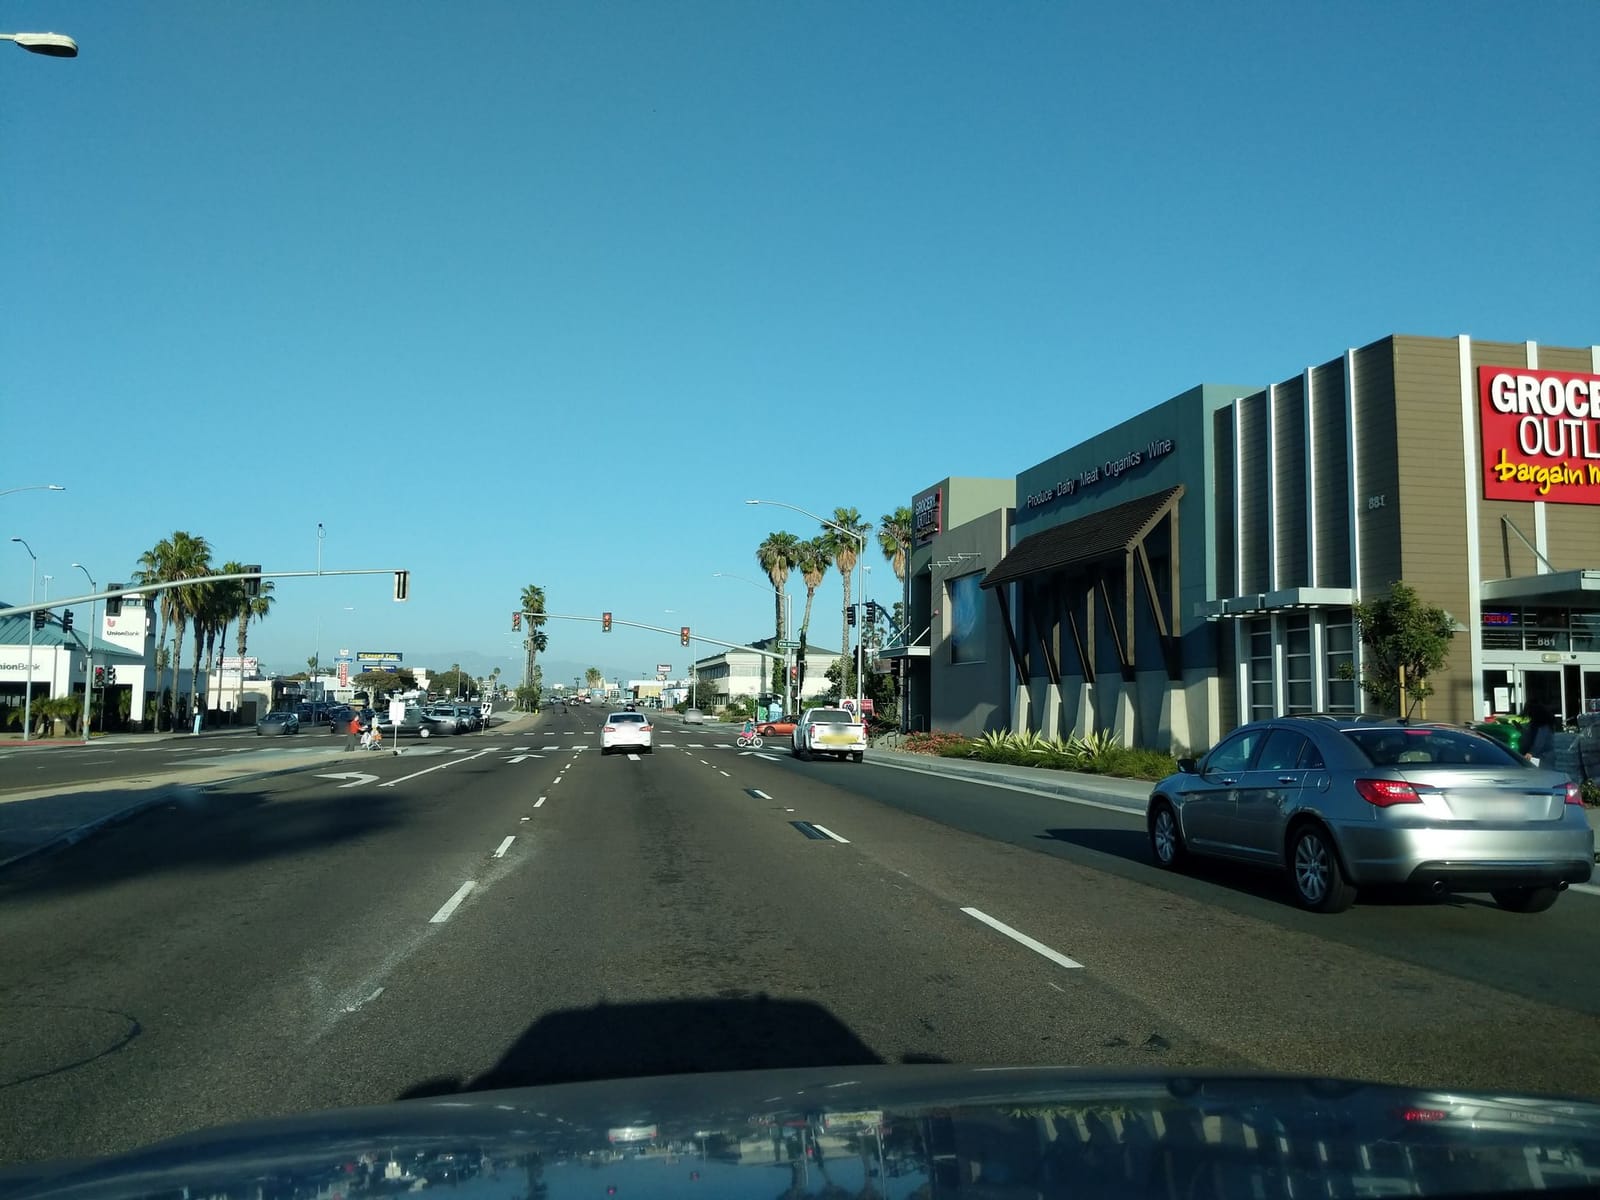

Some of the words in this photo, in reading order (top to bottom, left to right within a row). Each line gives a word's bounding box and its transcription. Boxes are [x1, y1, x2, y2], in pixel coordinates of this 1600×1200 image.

[1026, 486, 1053, 508] Produce
[1056, 477, 1076, 496] Dairy
[1079, 466, 1100, 487] Meat
[1104, 450, 1141, 477] Organics
[1147, 438, 1172, 460] Wine
[1494, 447, 1584, 494] bargain
[1537, 636, 1556, 647] 881
